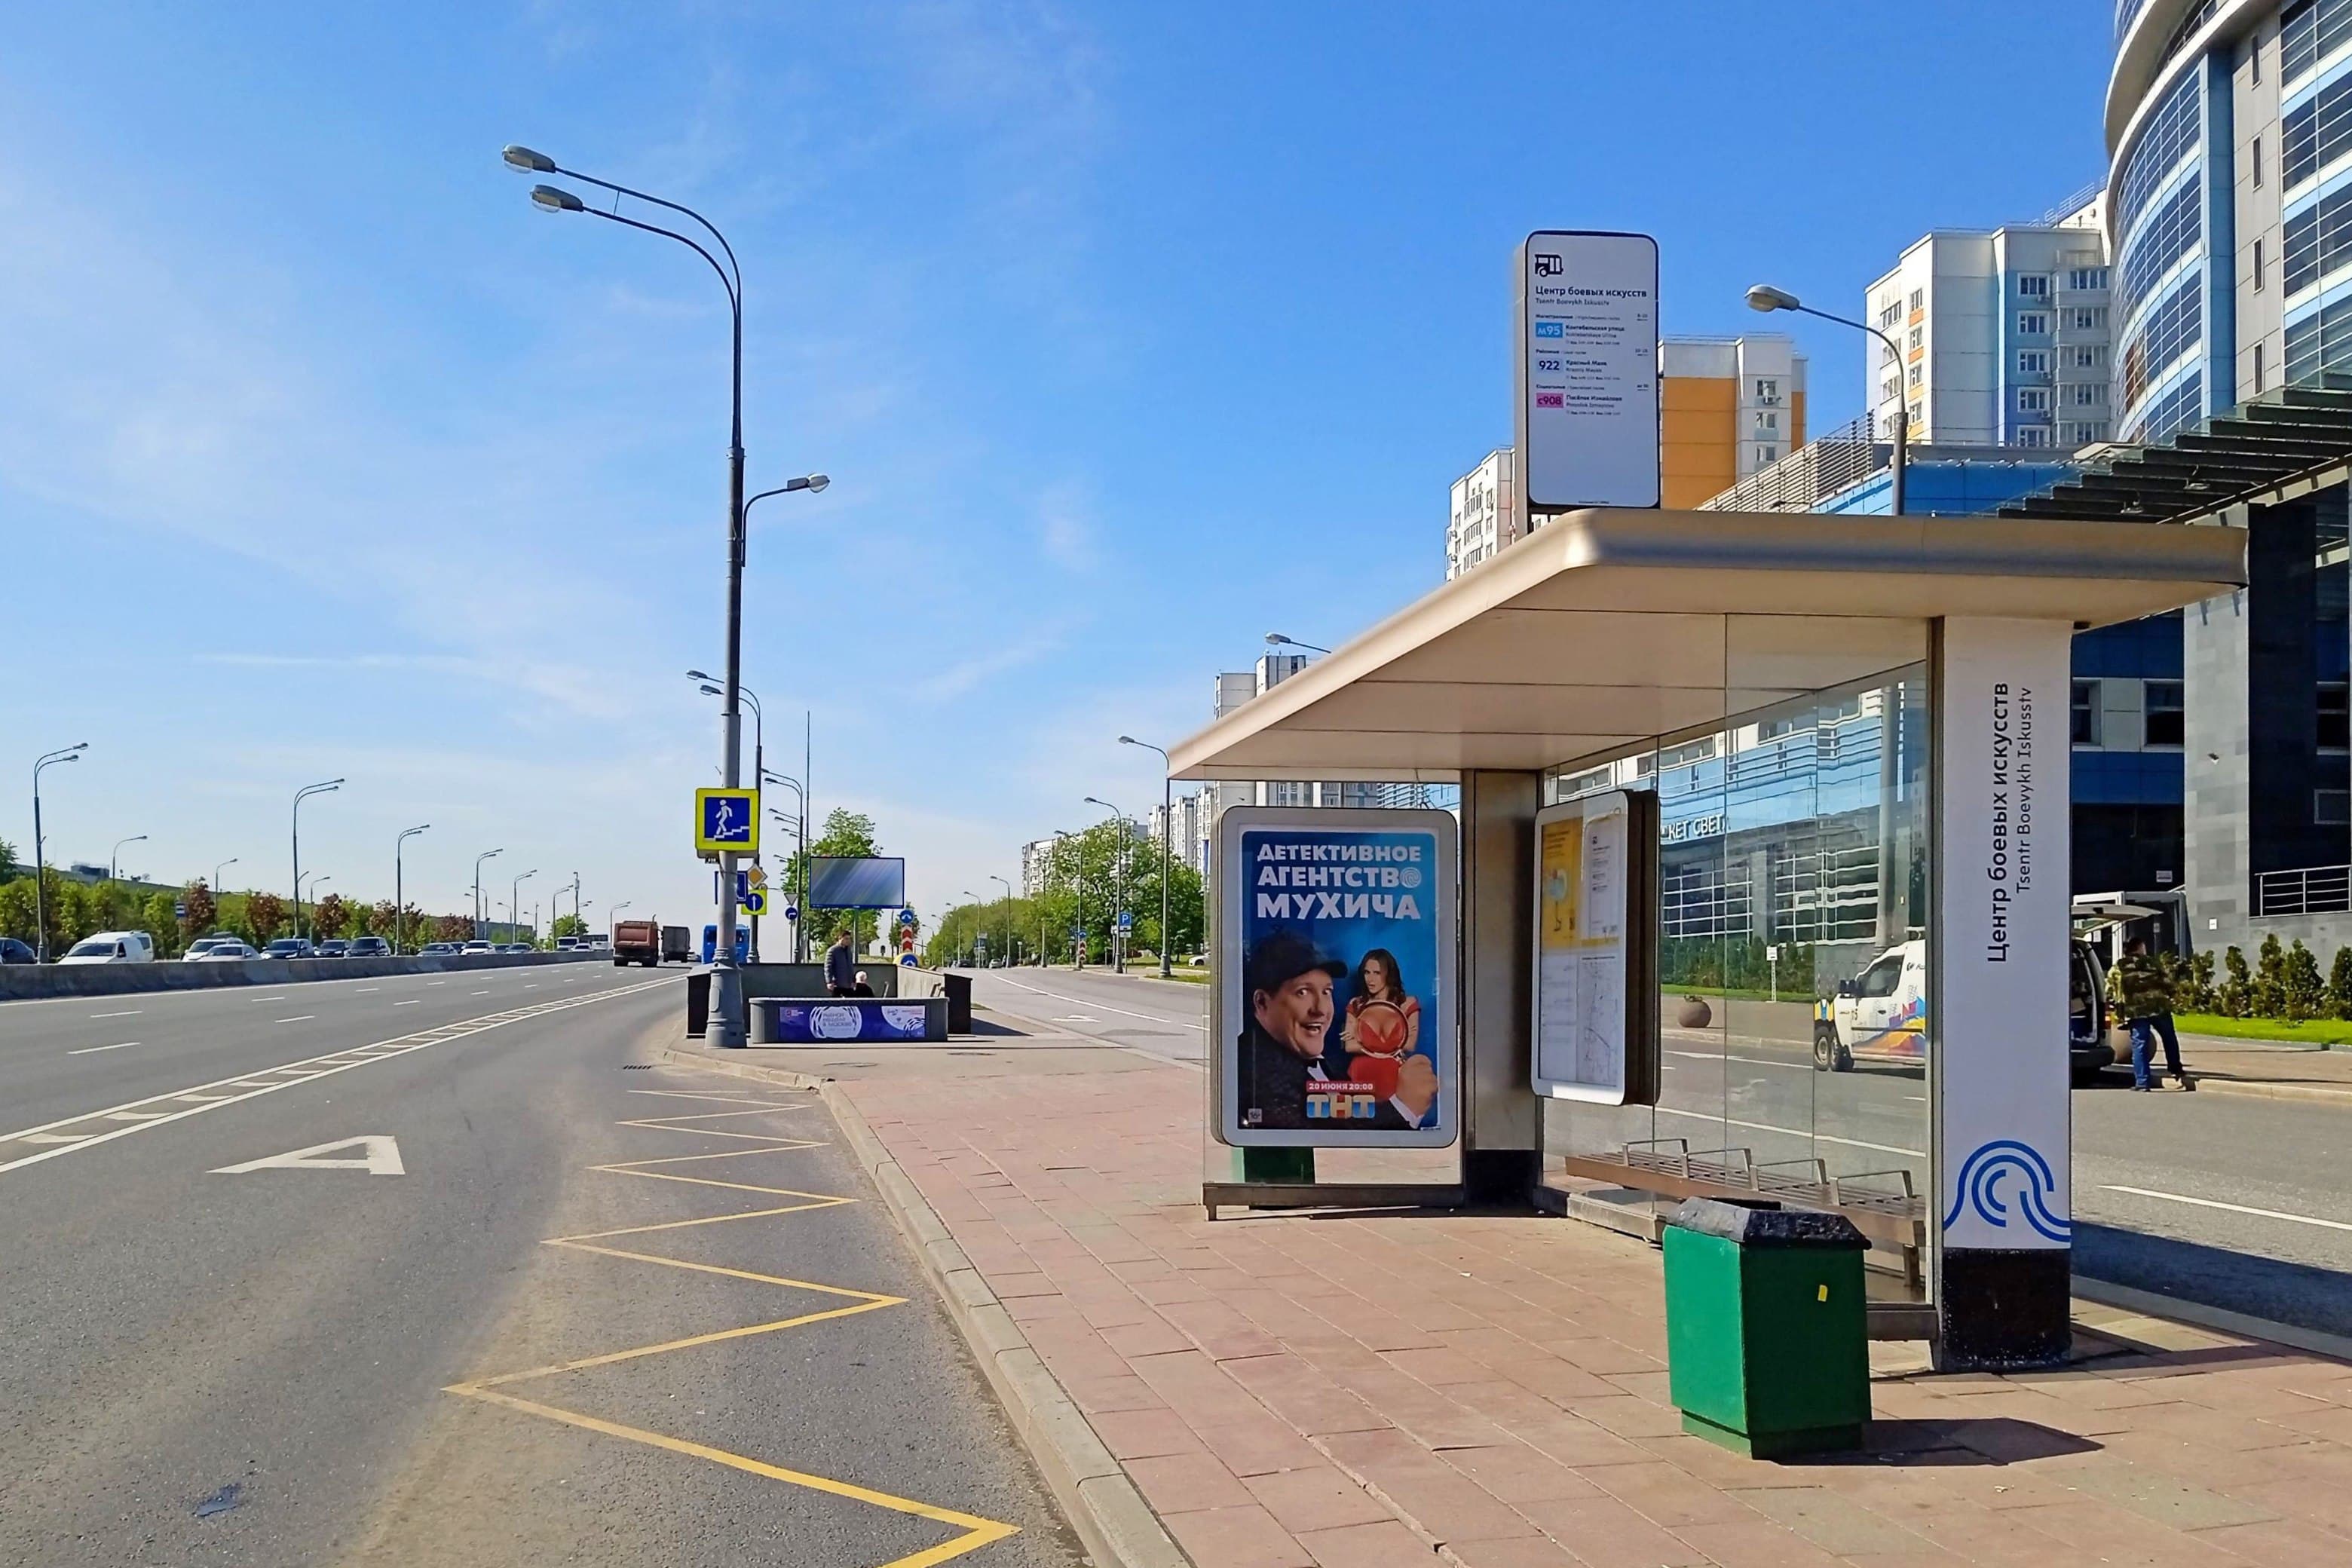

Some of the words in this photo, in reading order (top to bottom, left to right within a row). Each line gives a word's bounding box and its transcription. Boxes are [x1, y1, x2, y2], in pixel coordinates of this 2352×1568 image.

[1536, 286, 1566, 296] Центр
[1568, 286, 1603, 296] боевых
[1606, 288, 1647, 299] искусств
[1539, 360, 1560, 371] 922
[1993, 682, 2013, 786] искусств
[2016, 687, 2032, 758] Iskusstv
[2016, 763, 2035, 835] Boevykh
[1987, 792, 2008, 881] боевых
[1257, 844, 1422, 862] ДЕТЕКТИВНОЕ
[2016, 838, 2031, 894] Tsentr
[1257, 865, 1423, 889] АГЕНТСТВО
[1122, 914, 1129, 923] P
[1257, 891, 1421, 920] МУХИЧА
[1987, 887, 2011, 963] Центр
[1308, 1083, 1320, 1091] 20
[1321, 1083, 1348, 1091] ИЮНЯ
[1349, 1083, 1374, 1092] 20:00
[1306, 1095, 1376, 1119] ТНТ
